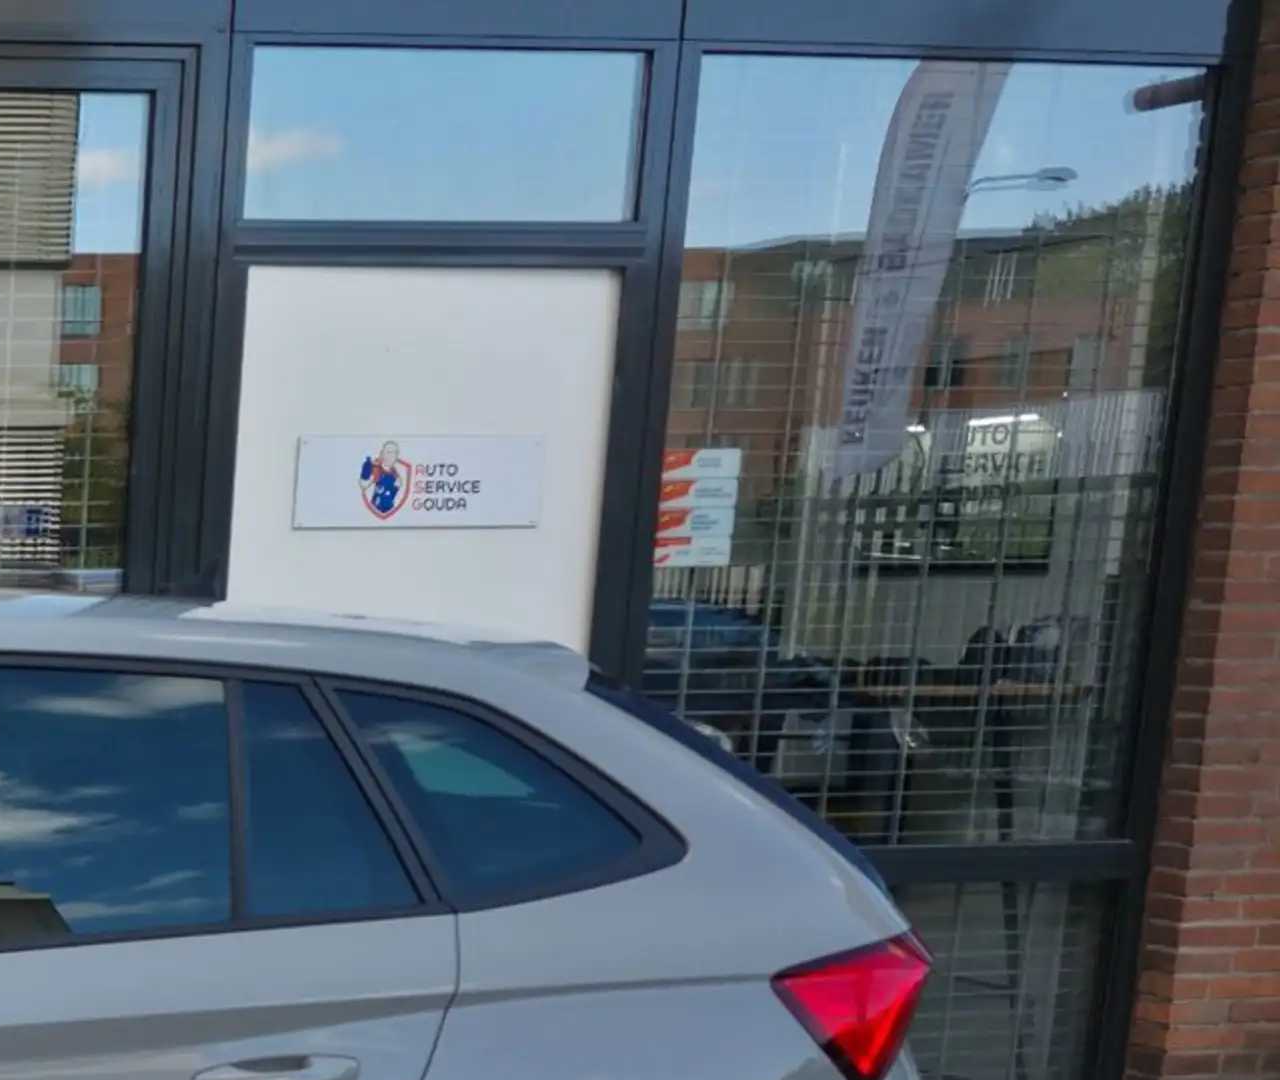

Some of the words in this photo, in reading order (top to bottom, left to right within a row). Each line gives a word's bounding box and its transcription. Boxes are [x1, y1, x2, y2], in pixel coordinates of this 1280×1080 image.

[415, 464, 459, 477] AUTO
[413, 480, 481, 494] SERVICE
[412, 497, 467, 511] GOUDA
